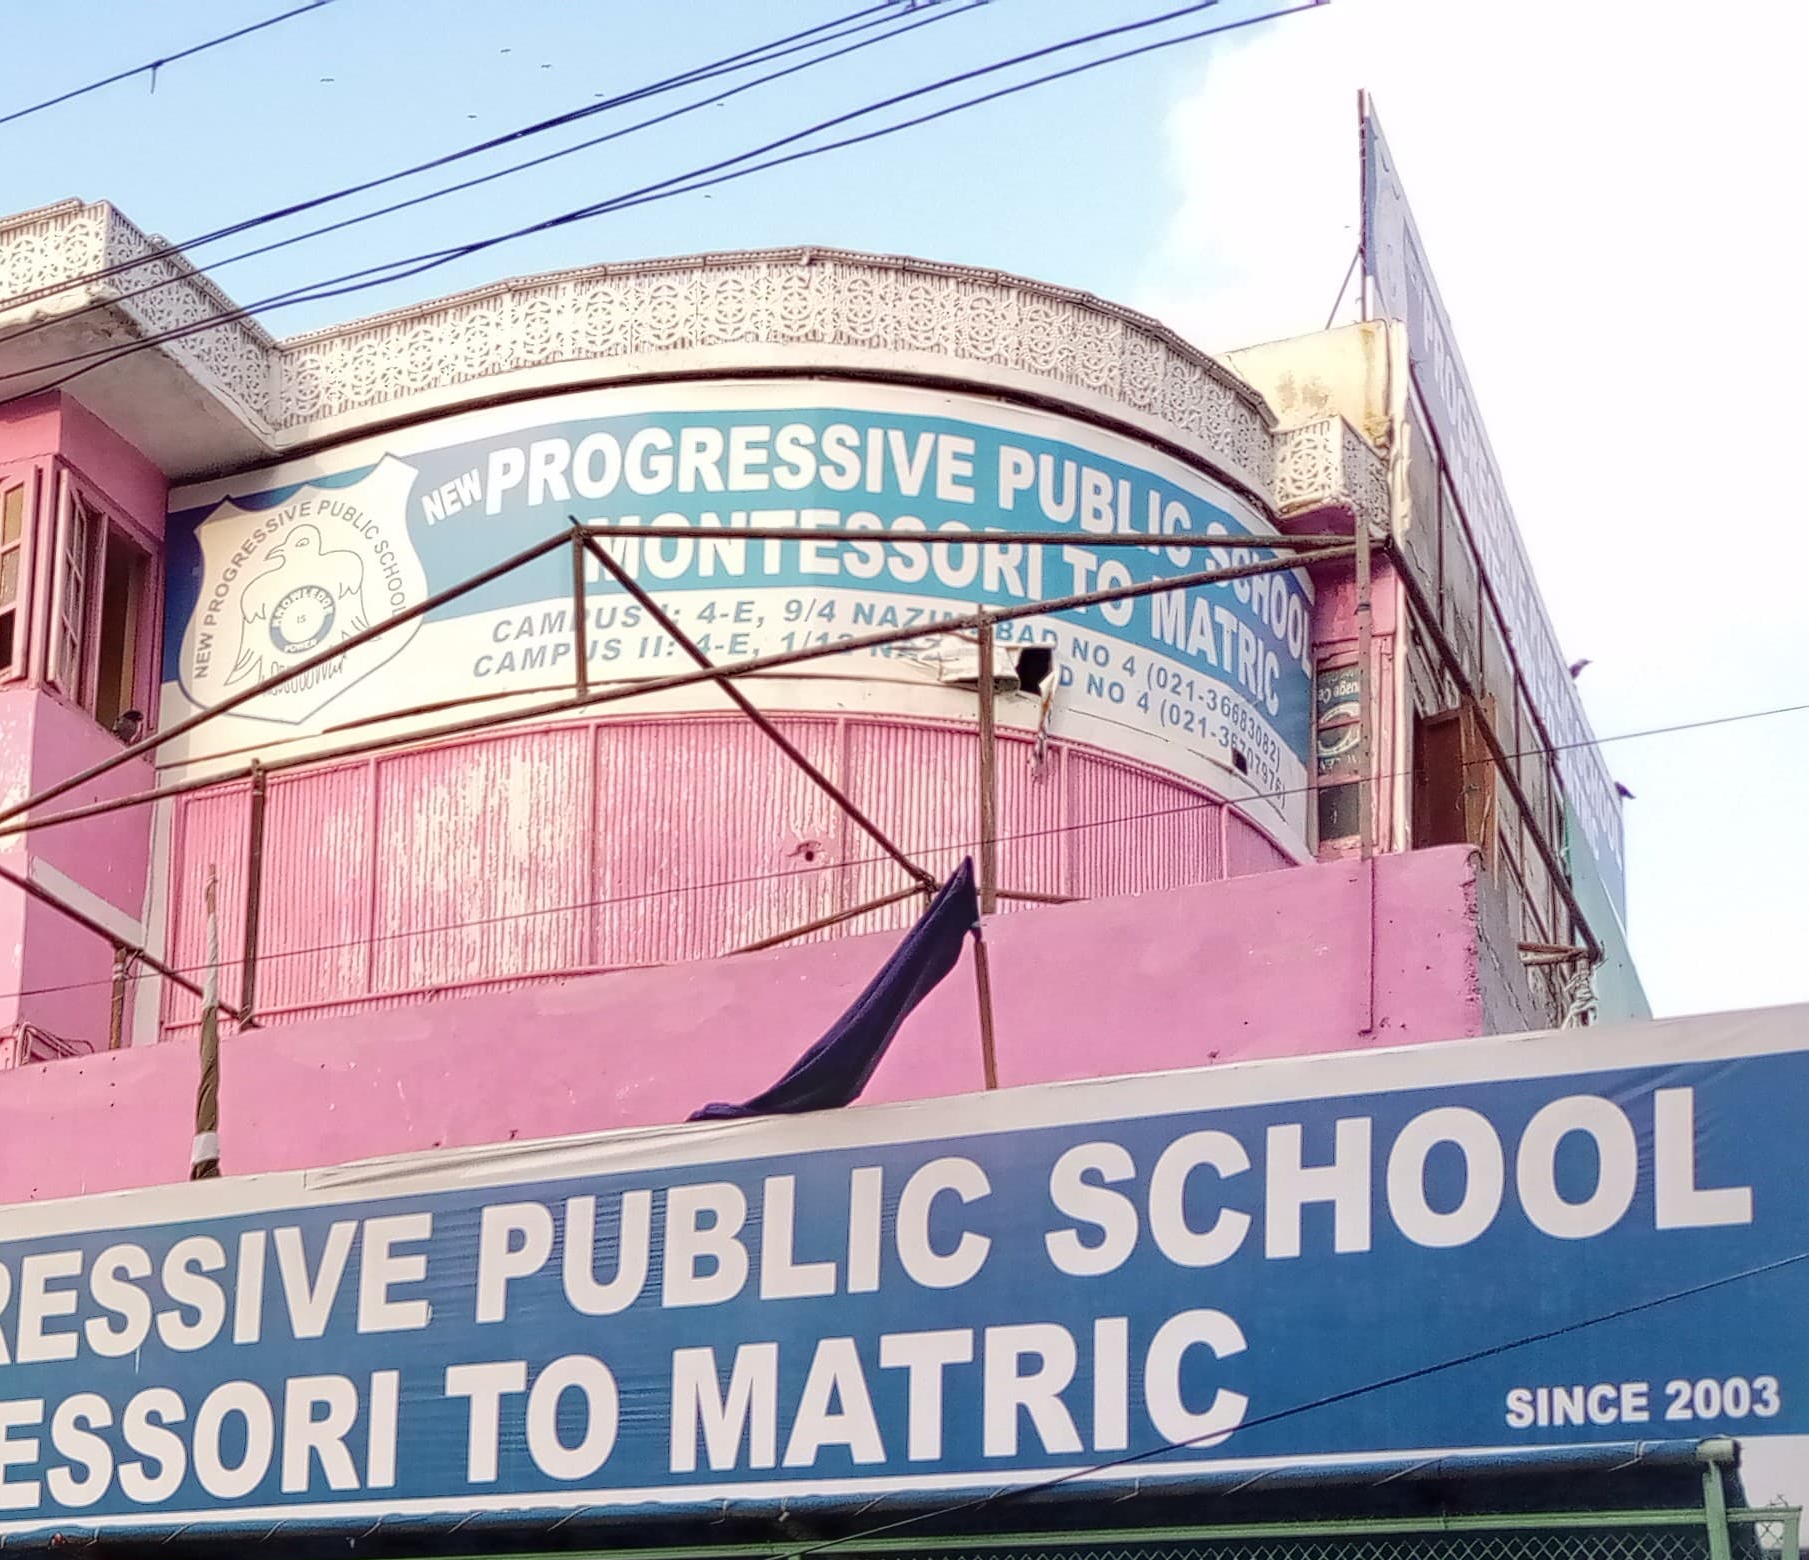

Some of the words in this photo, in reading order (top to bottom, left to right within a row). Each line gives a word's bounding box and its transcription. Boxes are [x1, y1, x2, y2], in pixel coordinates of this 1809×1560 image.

[194, 633, 214, 680] NEW
[204, 501, 312, 626] PROGRESSIVE
[317, 499, 380, 541] PUBLIC
[374, 540, 406, 615] SCHOOL
[421, 469, 482, 525] NEW
[485, 423, 976, 515] PROGRESSIVE
[999, 446, 1193, 567] PUBLIC
[1205, 521, 1313, 679] SCHOOL
[584, 508, 1043, 600] MONTESSORI
[1063, 544, 1133, 627] TO
[1151, 574, 1280, 717] MATRIC
[638, 636, 676, 658] II:
[1087, 673, 1125, 704] NO
[1136, 692, 1149, 714] 4
[696, 600, 764, 628] 4-E,
[783, 598, 836, 623] 9/4
[1072, 638, 1109, 667] NO
[1122, 655, 1136, 677] 4
[1148, 662, 1280, 773] (021-36683082)
[475, 1155, 992, 1323] PUBLIC
[1043, 1086, 1754, 1277] SCHOOL
[445, 1353, 618, 1482] TO
[668, 1308, 1250, 1474] MATRIC
[1504, 1380, 1652, 1430] SINCE
[1664, 1375, 1781, 1420] 2003
